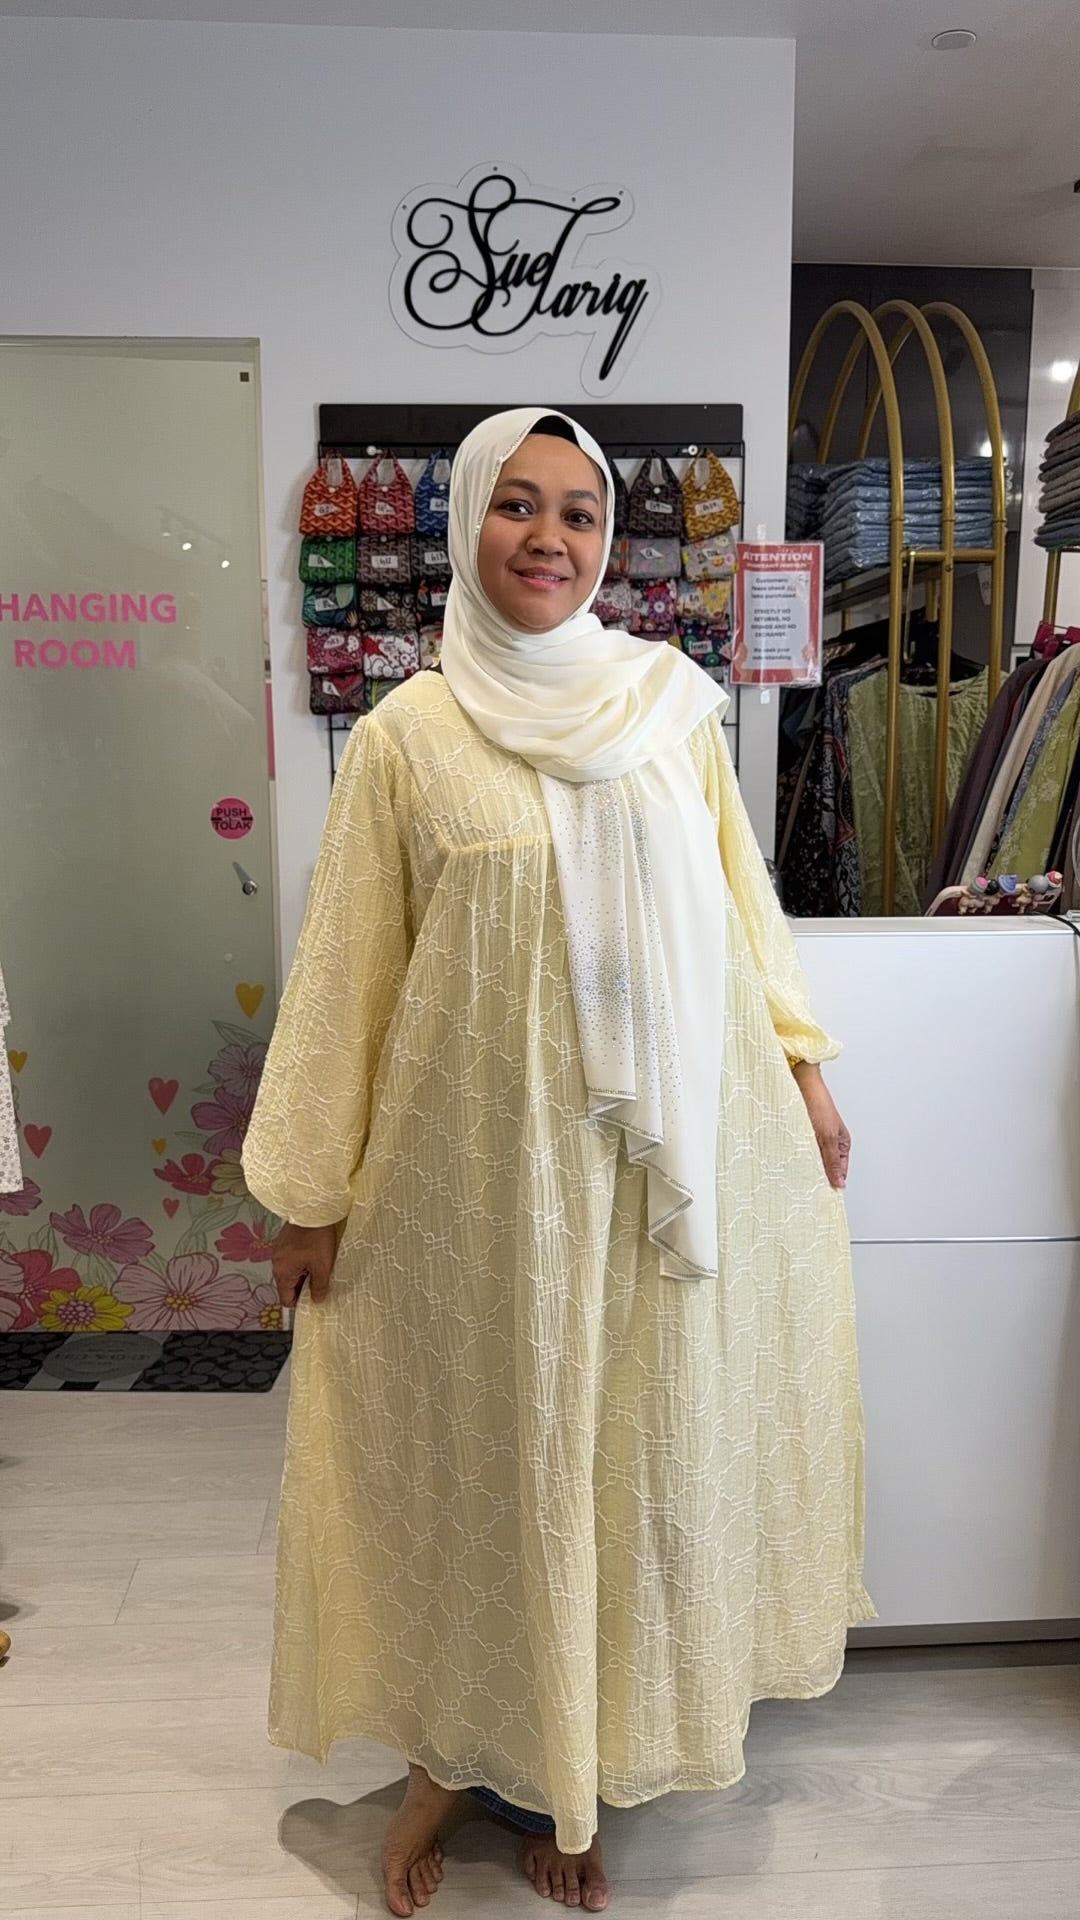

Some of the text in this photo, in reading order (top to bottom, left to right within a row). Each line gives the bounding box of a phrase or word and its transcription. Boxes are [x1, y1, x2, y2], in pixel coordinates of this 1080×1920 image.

[742, 551, 813, 562] ATTENTION
[0, 592, 177, 624] HANGING
[14, 639, 137, 670] ROOM
[216, 807, 247, 817] PUSH
[214, 821, 251, 831] TOLAK
